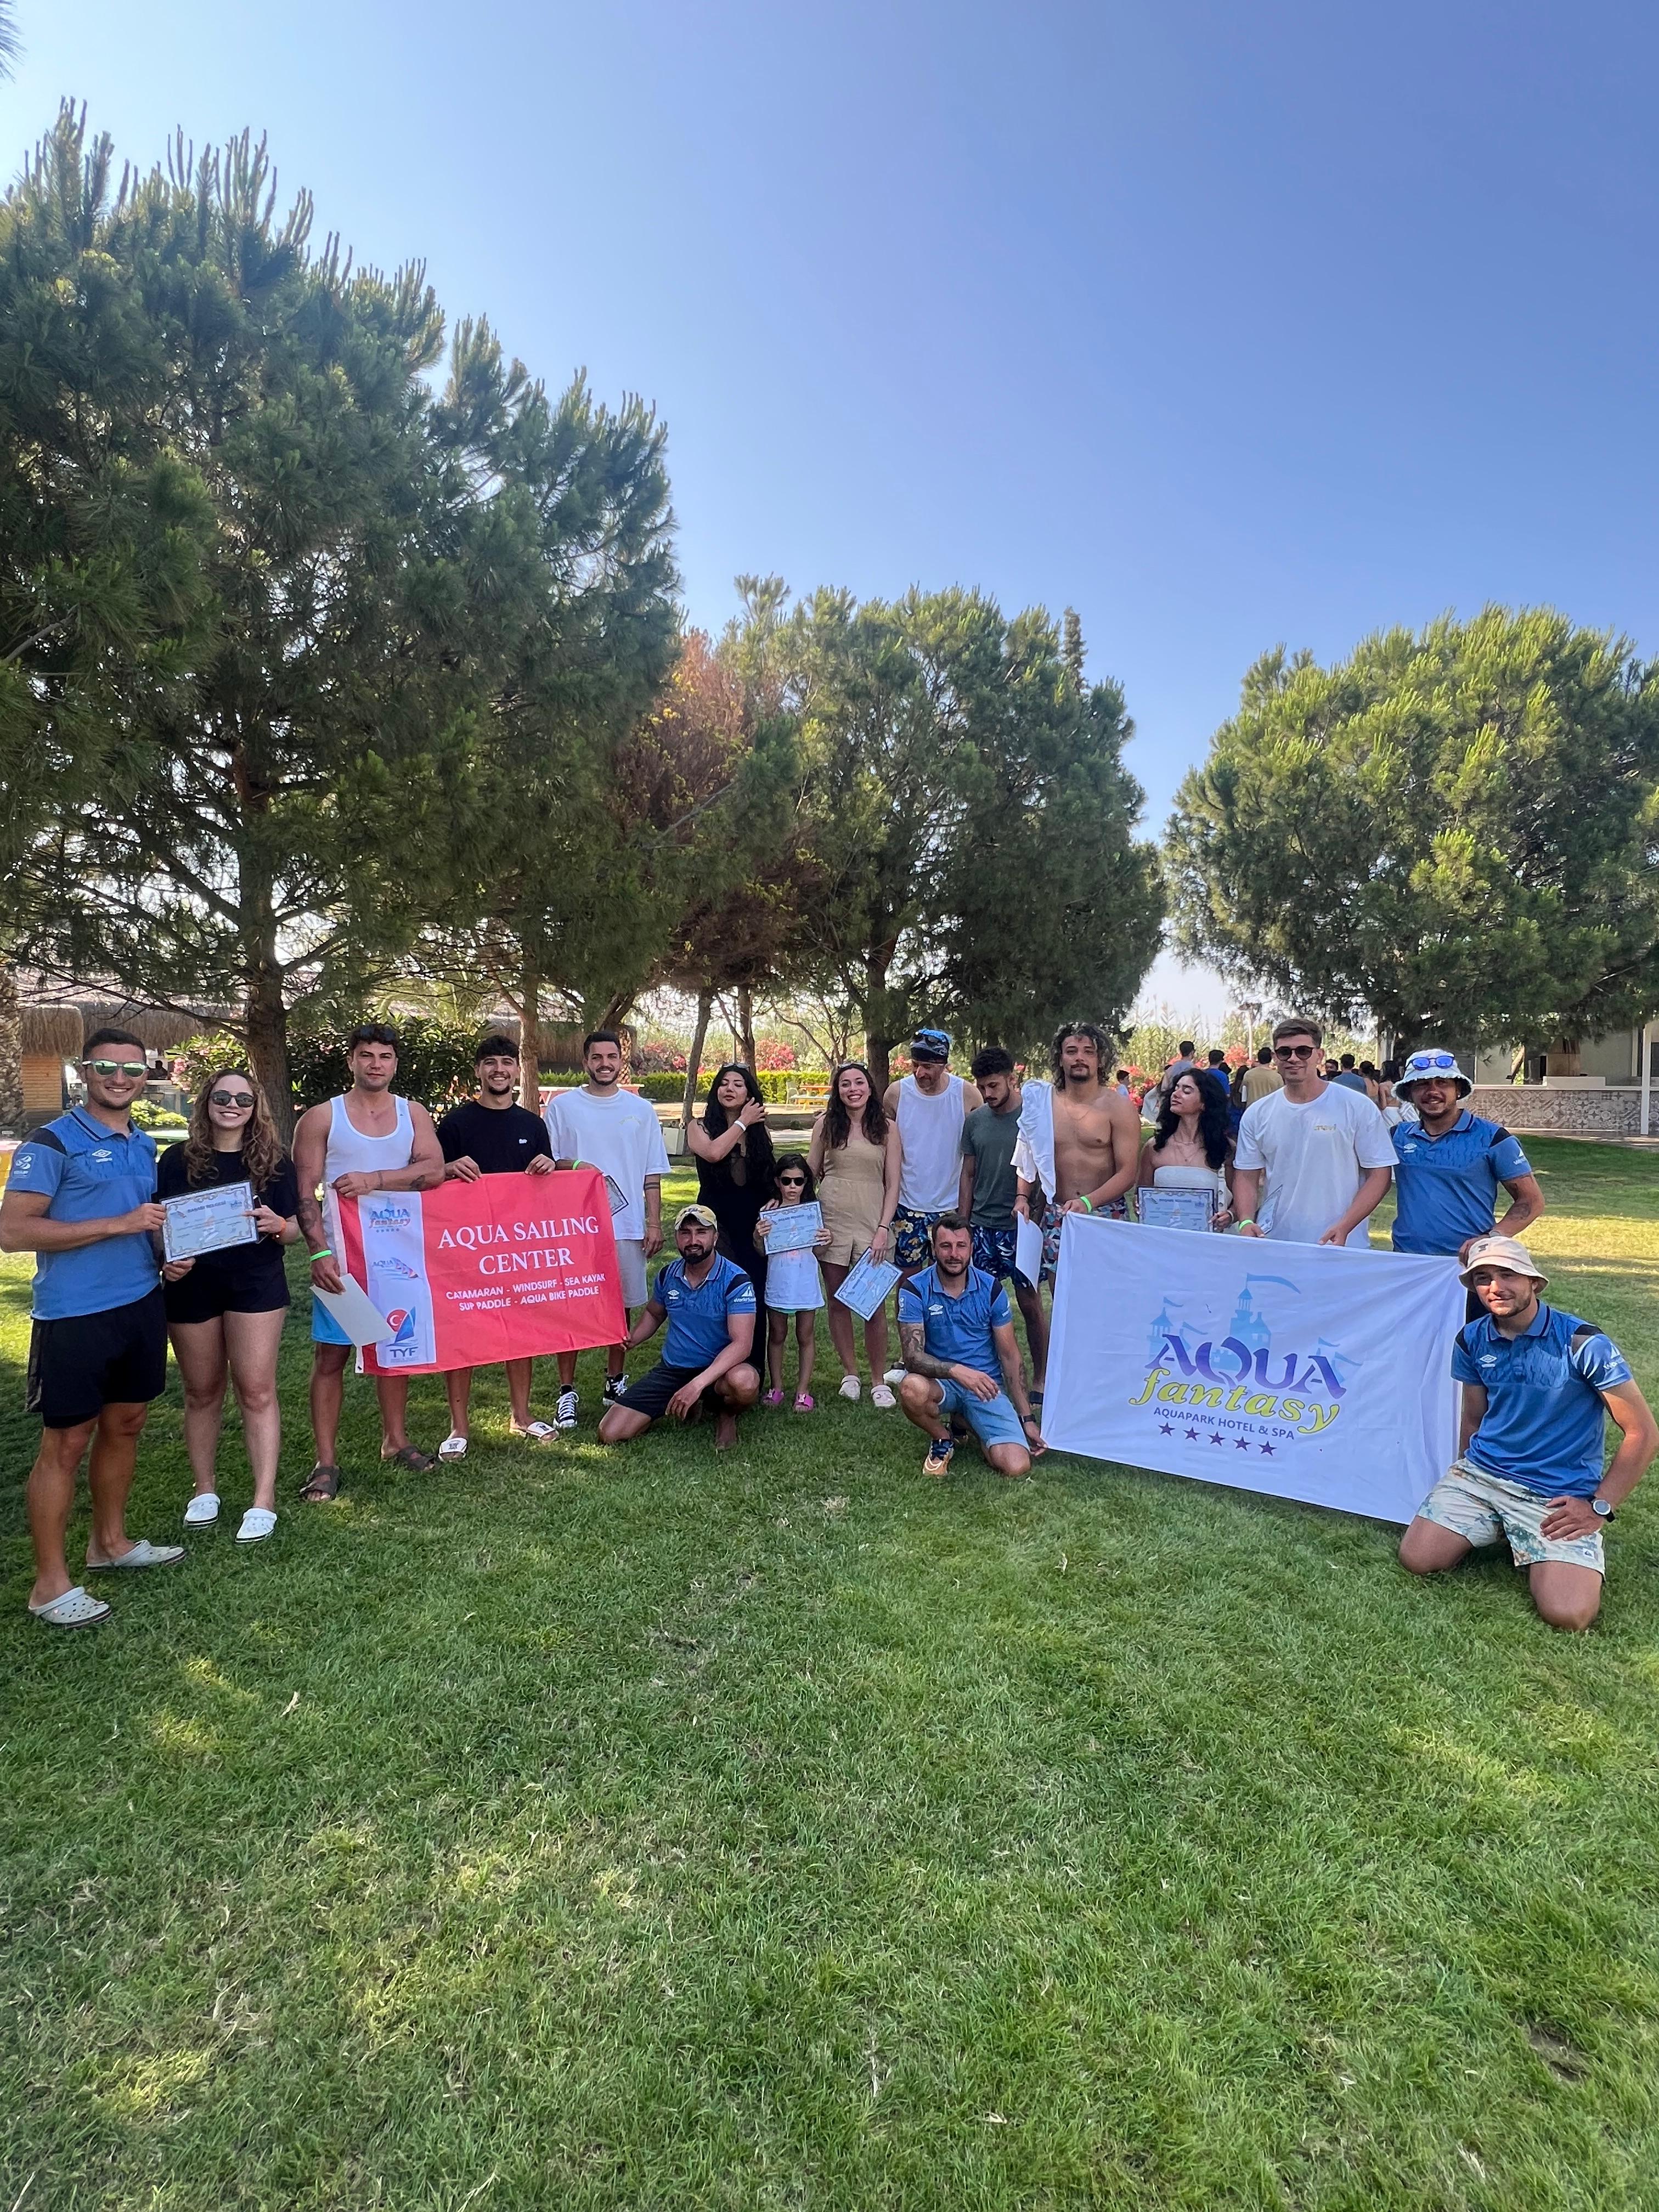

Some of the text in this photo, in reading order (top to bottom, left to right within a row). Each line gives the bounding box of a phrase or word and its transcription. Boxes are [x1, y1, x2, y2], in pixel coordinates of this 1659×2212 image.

[369, 1217, 411, 1229] fantasy
[370, 1209, 410, 1219] AQUA
[438, 1216, 599, 1251] AQUA SAILING
[479, 1248, 574, 1275] CENTER
[446, 1286, 504, 1300] CATAMARAN
[512, 1279, 557, 1293] WINDSURF
[565, 1277, 580, 1286] SEA
[582, 1273, 606, 1284] KAYAK
[459, 1302, 475, 1311] SUP
[477, 1297, 511, 1310] PADDLE
[520, 1295, 547, 1305] AQUA
[549, 1290, 566, 1301] BIKE
[568, 1286, 600, 1299] PADDLE
[390, 1346, 419, 1358] TYF
[1144, 1334, 1347, 1400] AQUA
[1128, 1367, 1340, 1434] fantasy
[1154, 1407, 1295, 1440] AQUAPARK HOTEL & SPA
